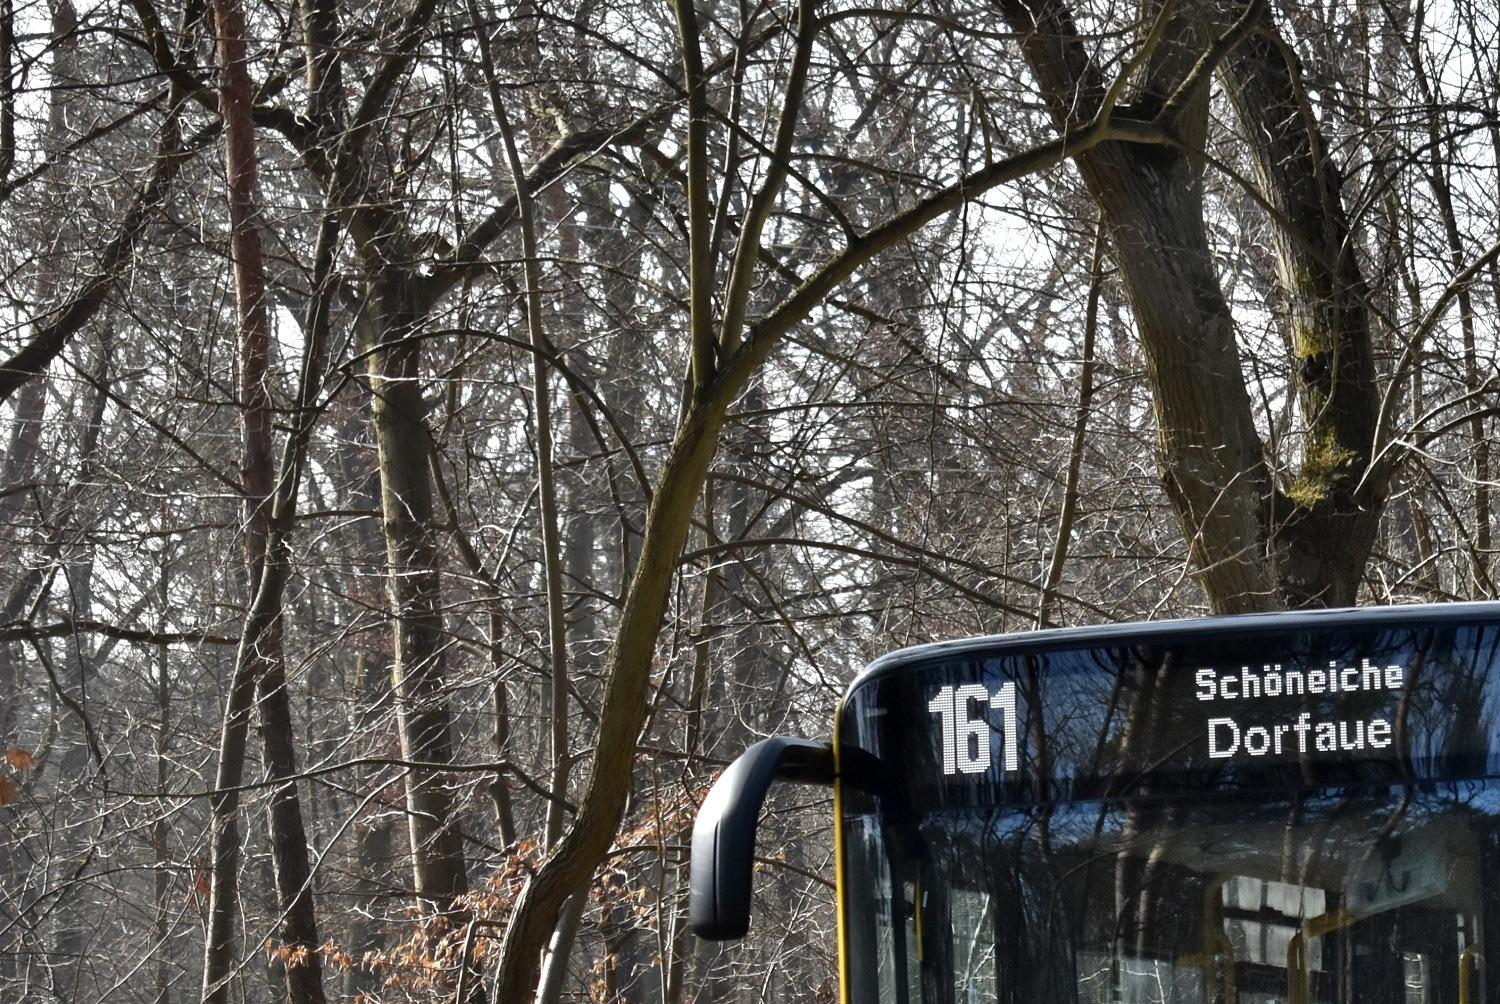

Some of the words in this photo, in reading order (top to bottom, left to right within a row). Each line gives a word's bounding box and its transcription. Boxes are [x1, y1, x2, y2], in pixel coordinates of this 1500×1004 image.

[1195, 658, 1403, 700] Schöneiche
[928, 682, 1017, 775] 161
[1208, 713, 1391, 758] Dorfaue
